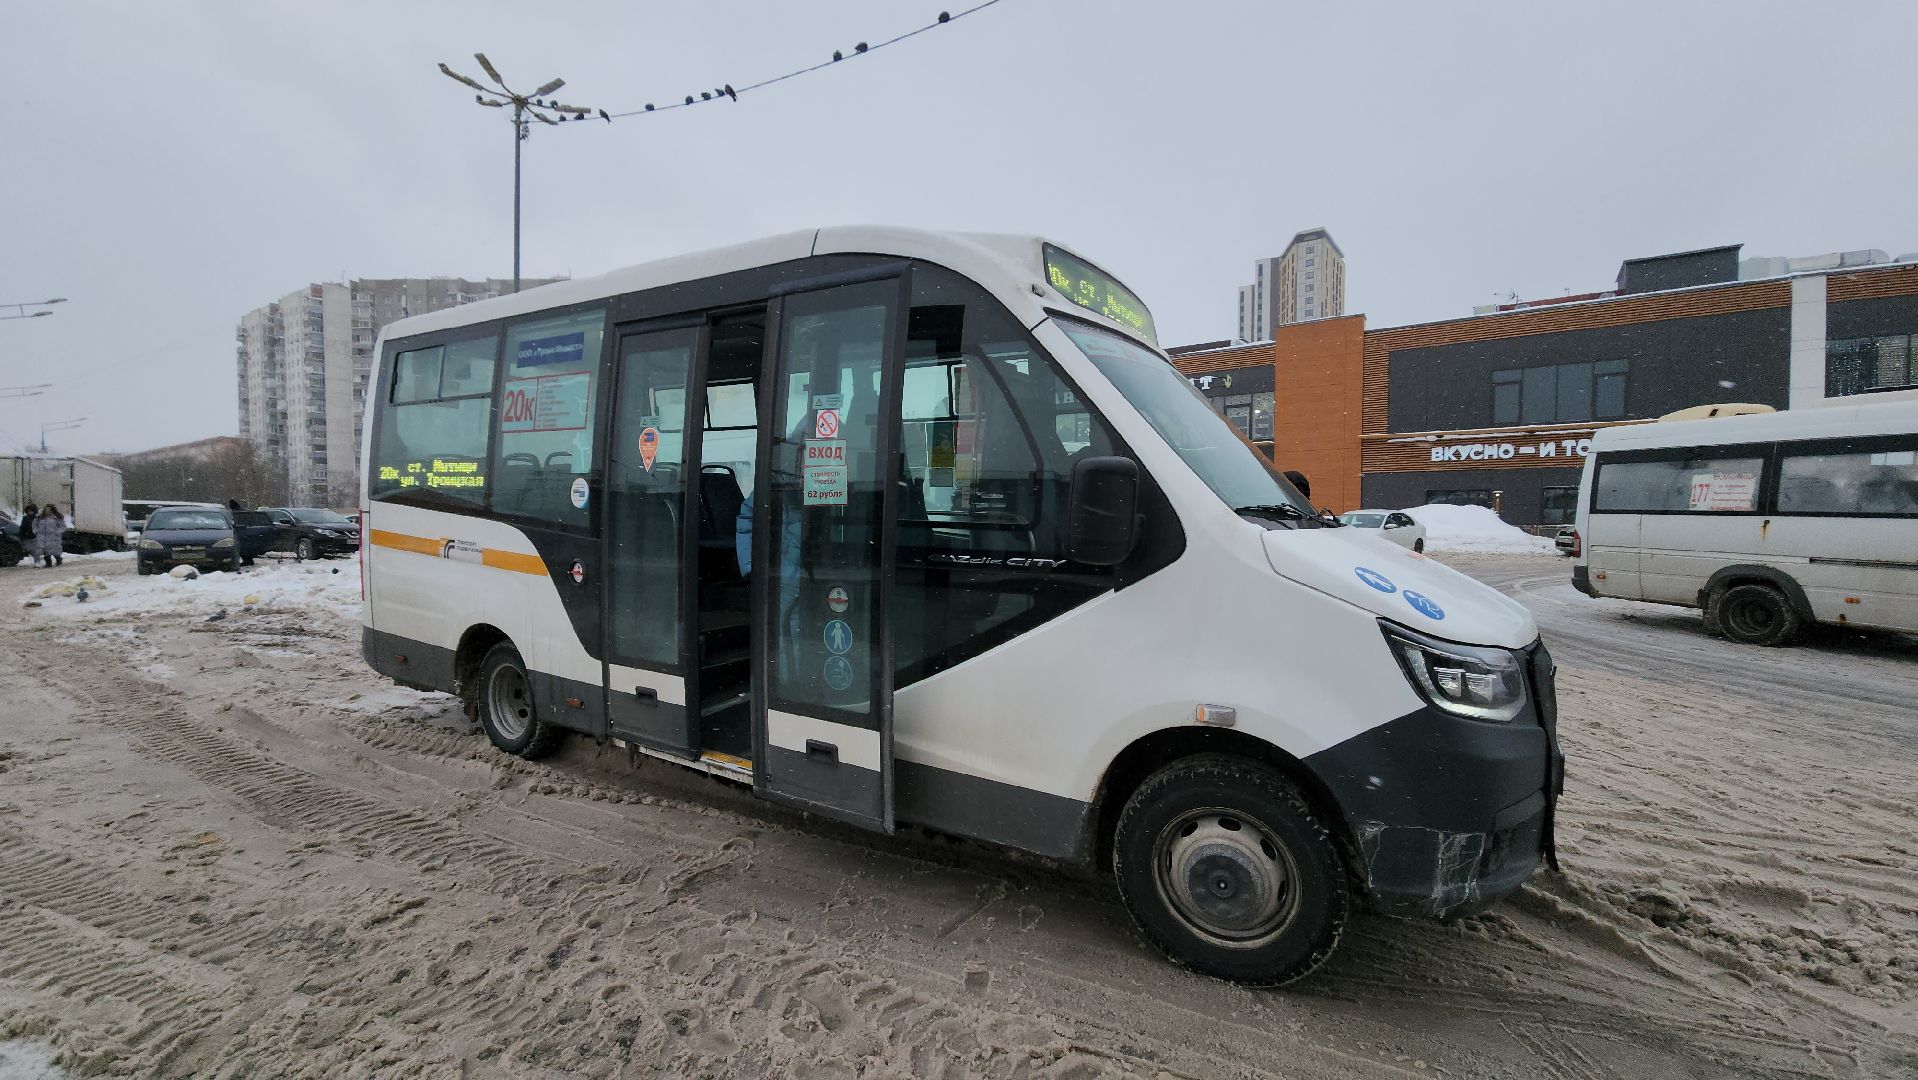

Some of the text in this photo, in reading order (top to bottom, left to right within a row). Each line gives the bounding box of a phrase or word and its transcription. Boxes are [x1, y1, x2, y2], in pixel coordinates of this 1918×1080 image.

[808, 446, 843, 461] ВХОД
[1430, 443, 1515, 462] ВКУСНО
[1539, 442, 1556, 458] И
[807, 489, 844, 501] 62 рубля
